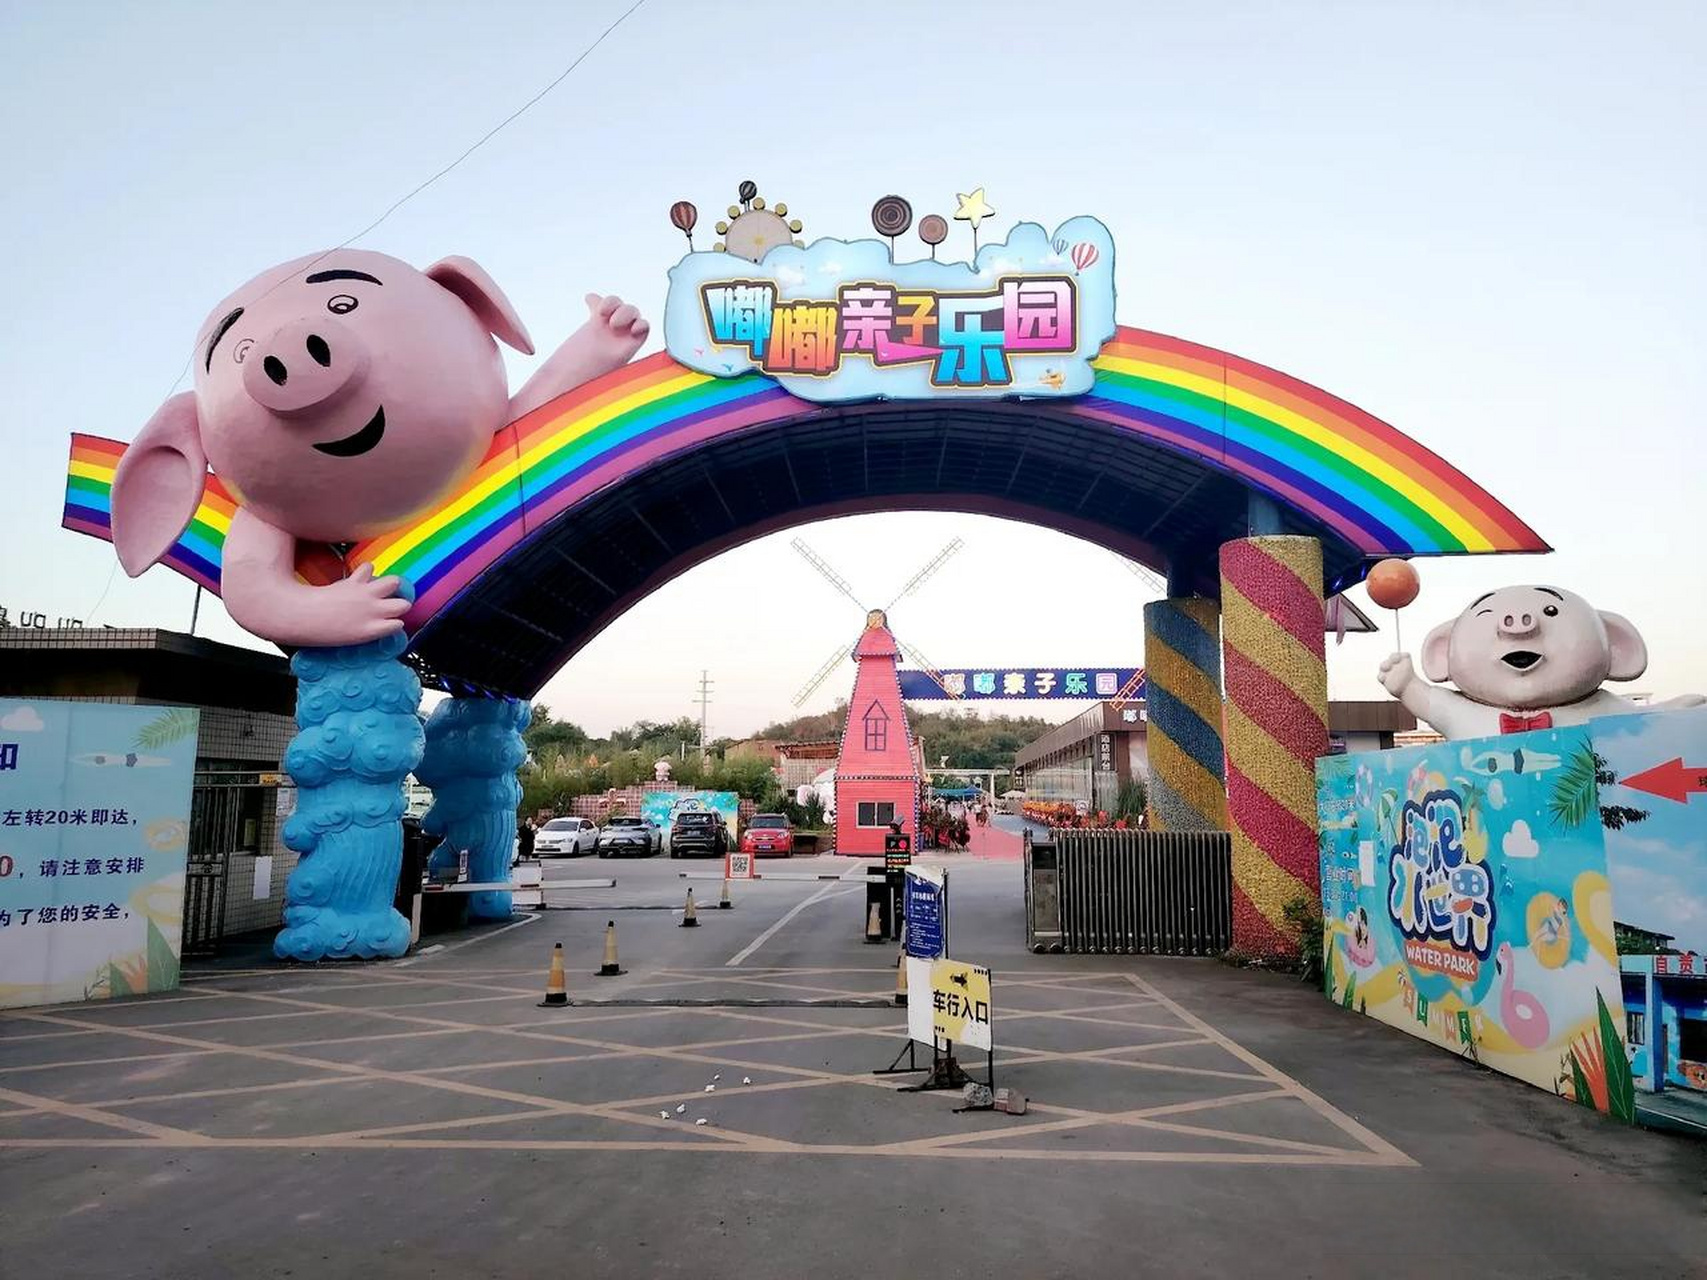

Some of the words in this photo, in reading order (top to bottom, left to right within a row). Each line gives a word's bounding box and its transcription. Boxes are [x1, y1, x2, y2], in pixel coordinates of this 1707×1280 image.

[702, 278, 1076, 384] 嘟嘟亲子乐园
[943, 672, 1118, 695] 嘟嘟亲子乐园
[2, 809, 137, 826] 左转20米即达，
[1406, 945, 1441, 967] WATER
[1443, 953, 1475, 976] PARK
[1656, 953, 1707, 975] 自贡
[933, 989, 988, 1025] 车行入口
